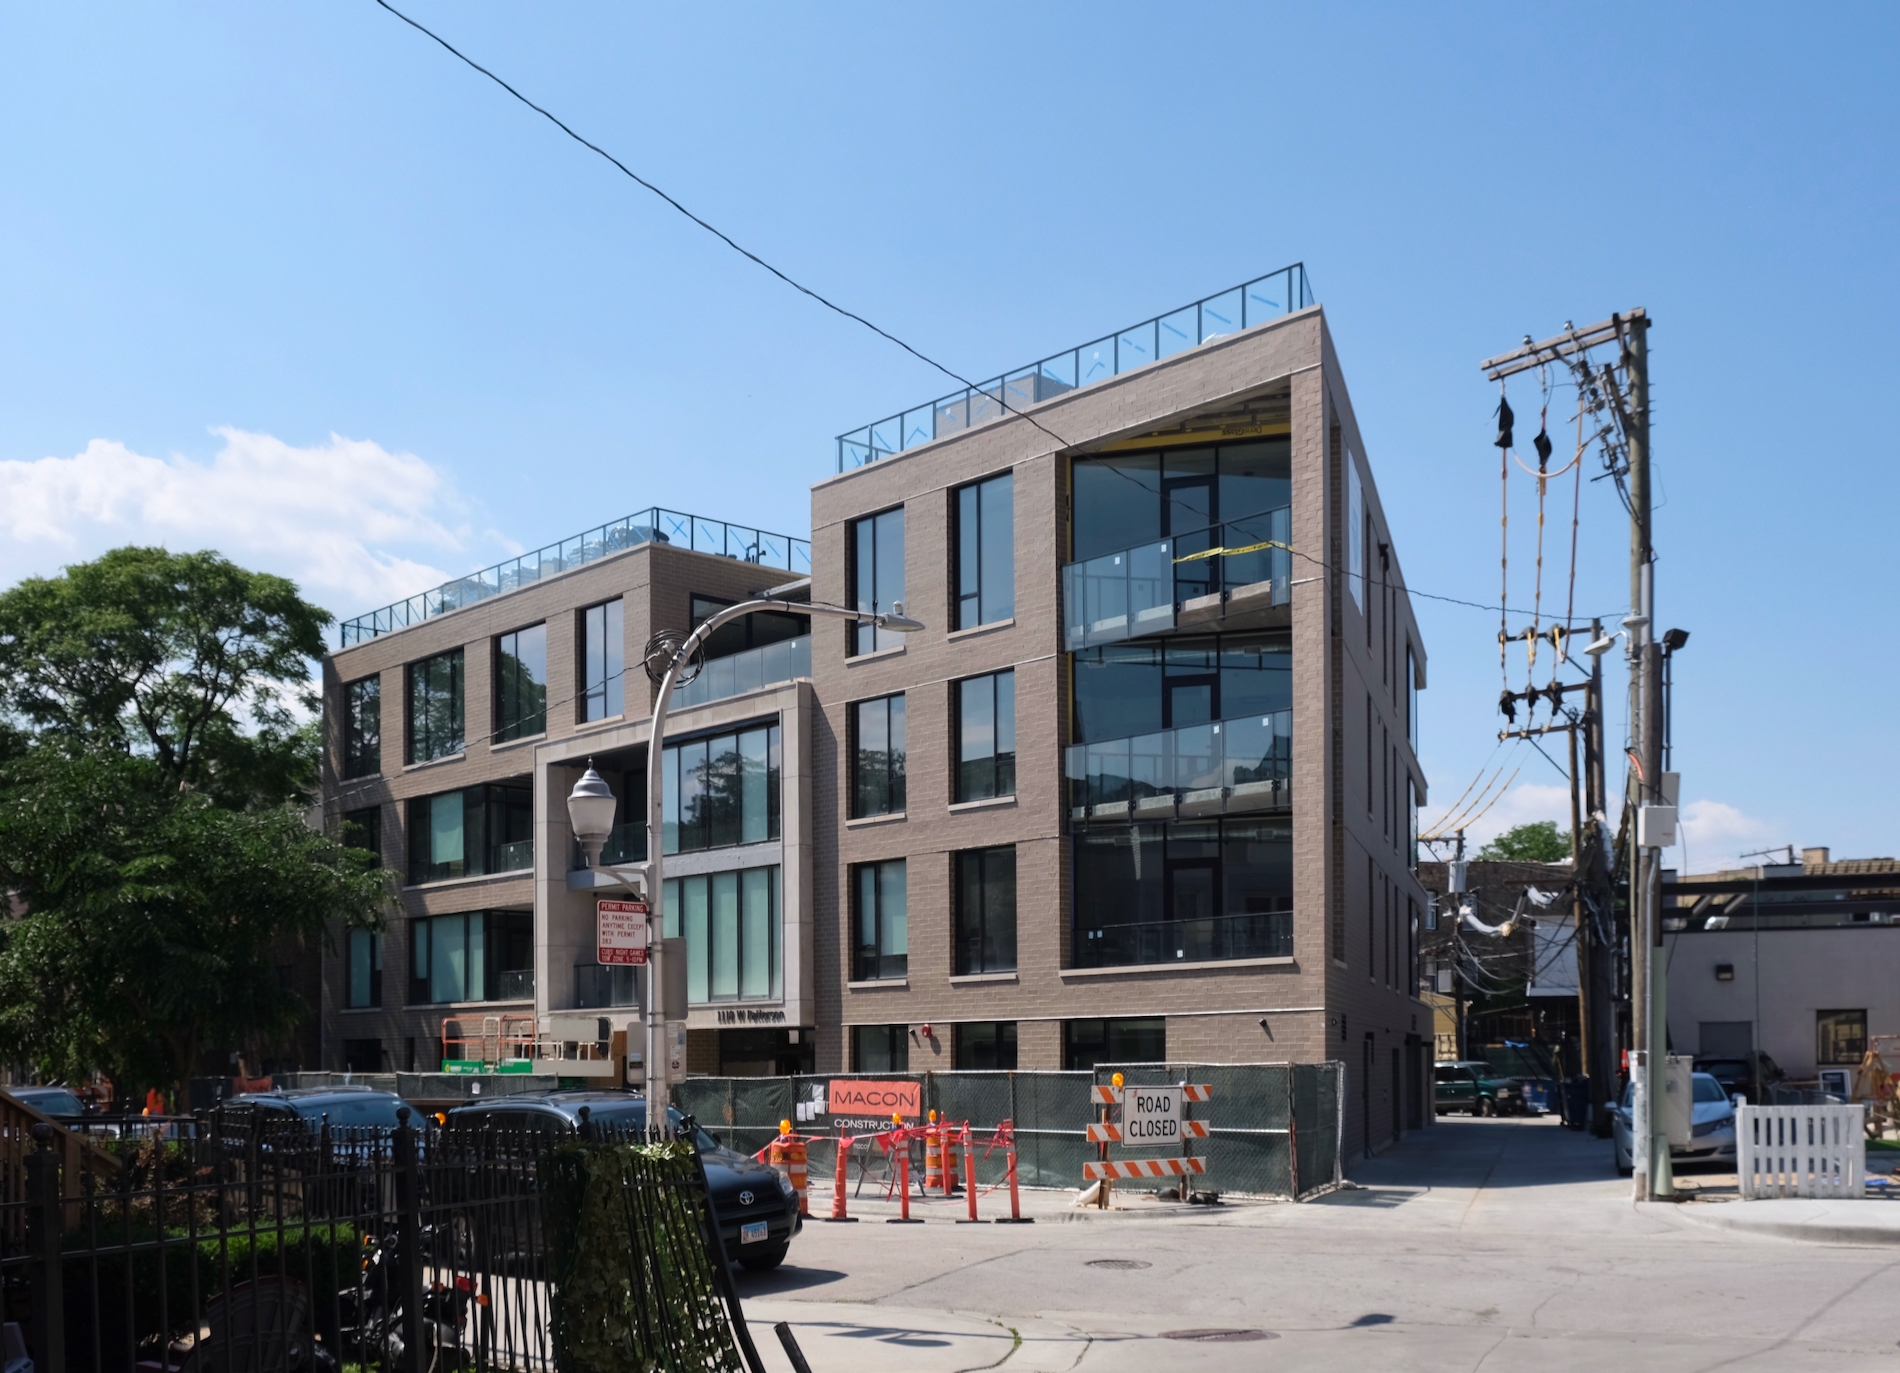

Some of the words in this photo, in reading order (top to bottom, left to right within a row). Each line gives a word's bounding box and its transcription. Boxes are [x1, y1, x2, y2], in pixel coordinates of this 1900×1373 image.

[601, 902, 620, 910] PERMIT
[622, 904, 644, 912] PARKING
[736, 1009, 747, 1023] W
[747, 1009, 786, 1024] Patterson
[834, 1091, 914, 1107] MACON
[1137, 1096, 1171, 1113] ROAD
[834, 1118, 914, 1130] CONSTRUCTN
[1129, 1120, 1177, 1137] CLOSED
